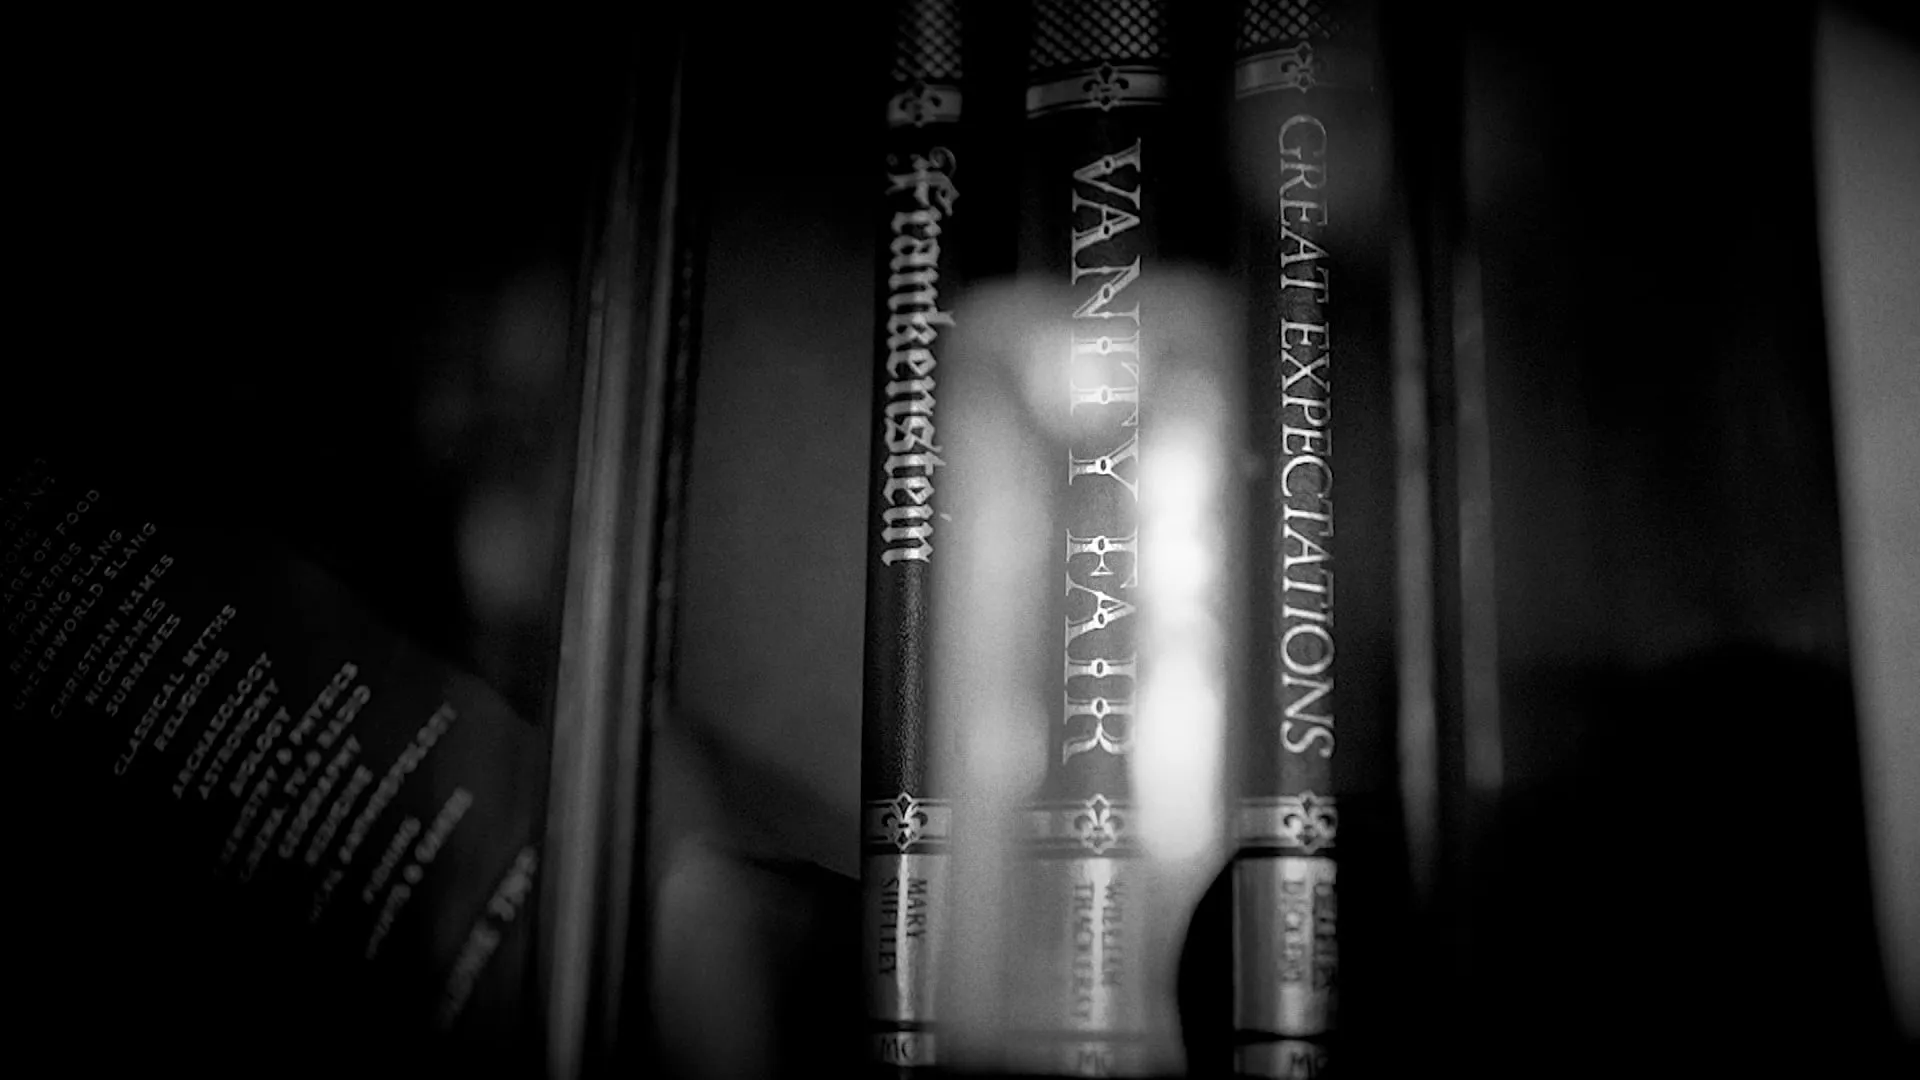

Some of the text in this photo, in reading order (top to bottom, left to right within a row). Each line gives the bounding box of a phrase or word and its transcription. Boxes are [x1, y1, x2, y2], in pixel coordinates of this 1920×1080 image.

[882, 143, 960, 567] Frankenstein
[1063, 136, 1142, 765] VANITY FAIR
[1278, 114, 1337, 759] GREAT EXPECTATIONS
[56, 488, 100, 537] FOOD
[71, 528, 123, 587] SLANG
[103, 521, 157, 580] SLANG
[50, 553, 175, 720] CHRISTIAN NAMES
[84, 596, 166, 706] NICKNAMES
[105, 613, 182, 717] SURNAMES
[113, 603, 238, 776] CLASSICAL MYTHS
[153, 647, 230, 752] RELIGIONS
[878, 877, 899, 977] SHELLEY
[905, 878, 928, 940] MARY
